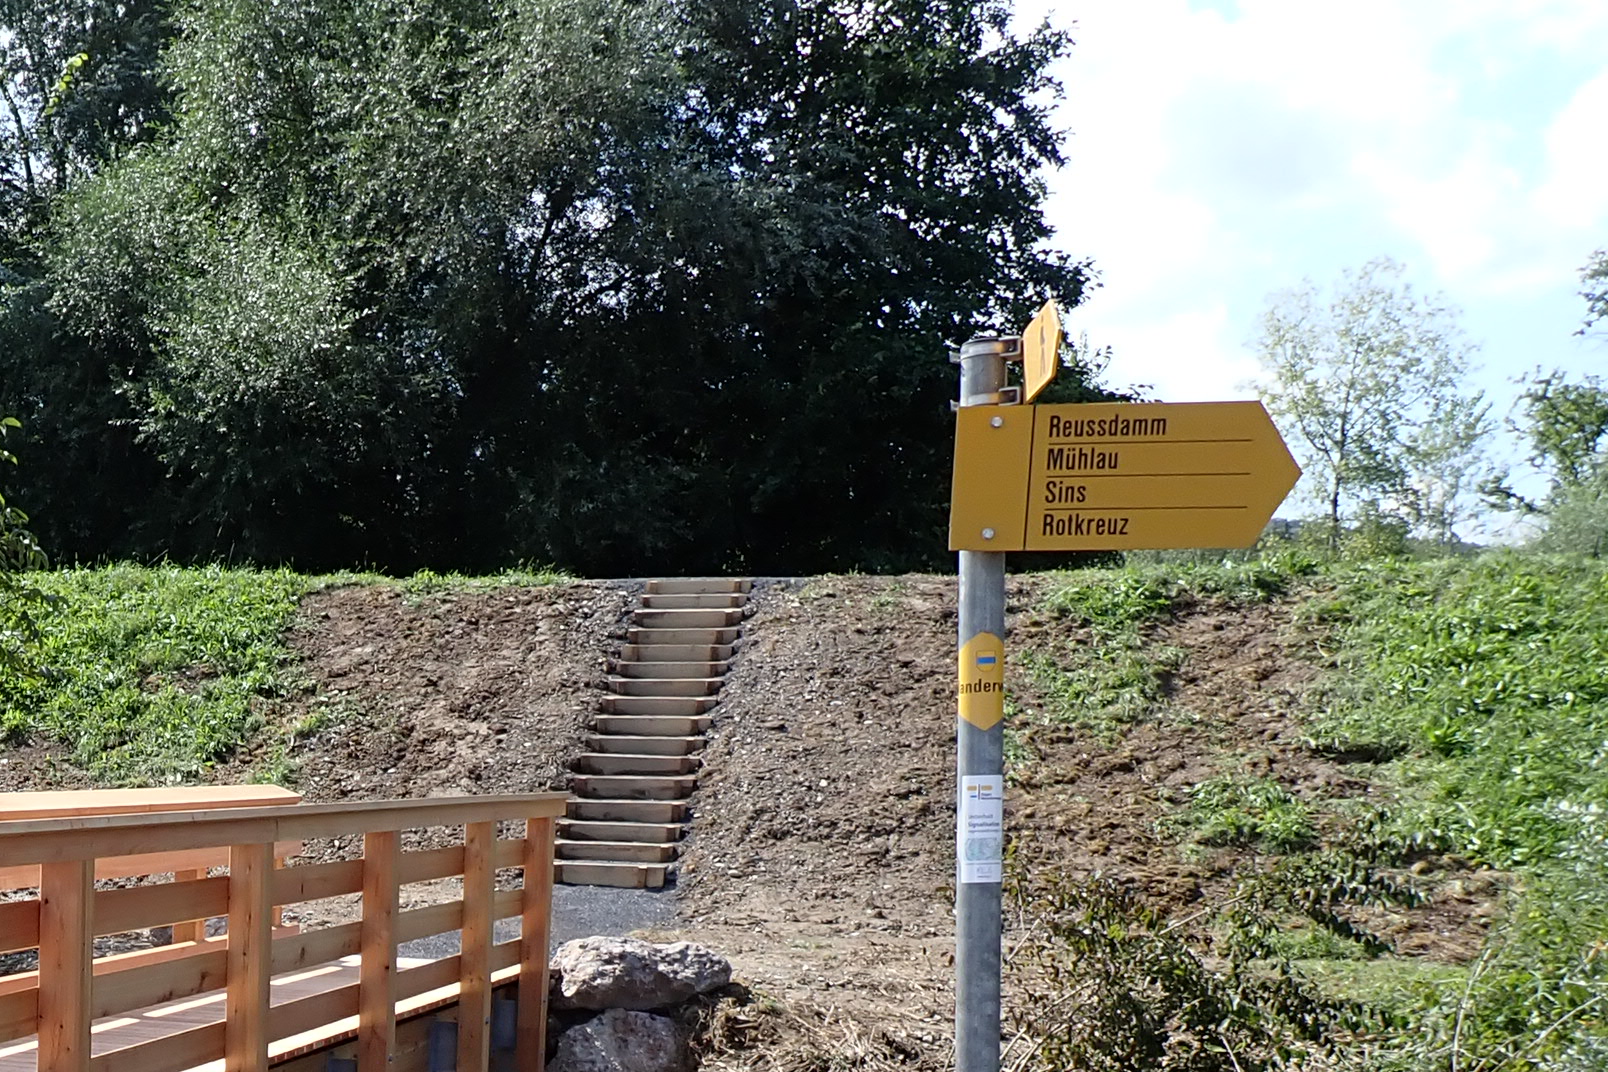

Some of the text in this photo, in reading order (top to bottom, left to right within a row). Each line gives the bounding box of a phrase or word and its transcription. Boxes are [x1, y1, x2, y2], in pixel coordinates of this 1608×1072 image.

[1049, 414, 1167, 438] Reussdamm
[1046, 447, 1119, 471] Mühlau
[1045, 481, 1087, 504] Sins
[1042, 513, 1129, 537] Rotkreuz
